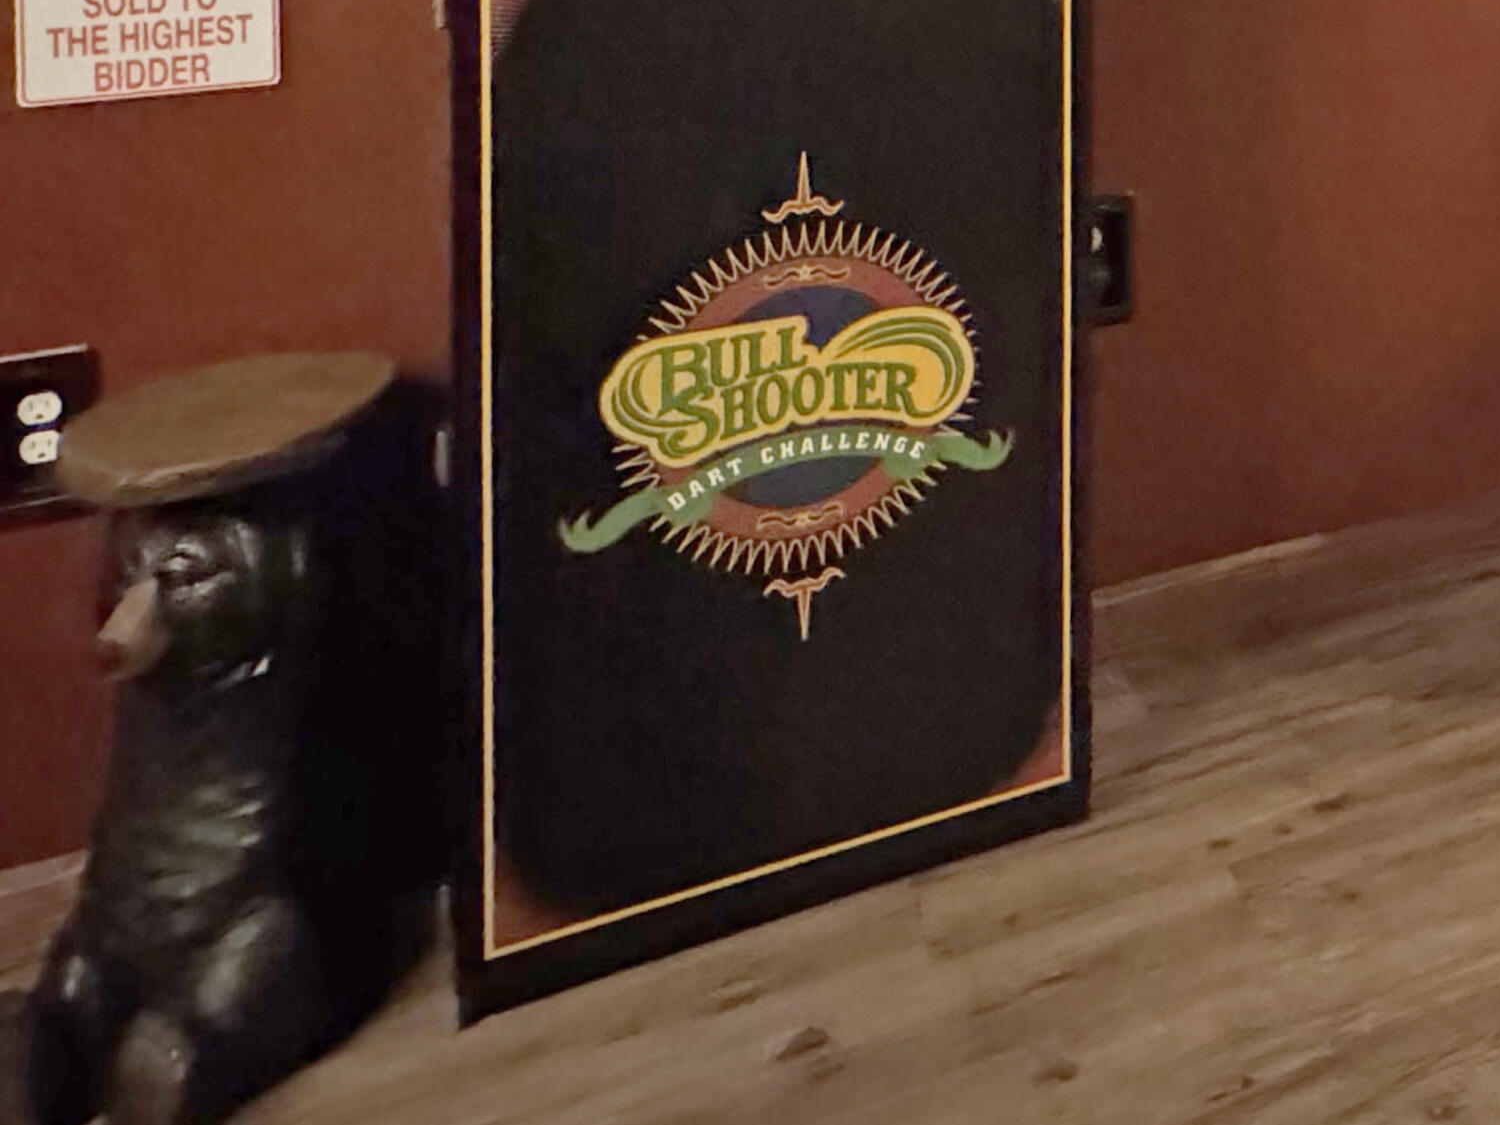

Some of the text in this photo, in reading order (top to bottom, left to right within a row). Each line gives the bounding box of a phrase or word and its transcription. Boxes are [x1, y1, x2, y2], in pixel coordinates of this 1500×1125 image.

[46, 14, 253, 58] THE HIGHEST
[94, 53, 211, 92] BIDDER
[658, 325, 809, 418] BULL
[658, 362, 930, 460] SHOOTER
[760, 431, 926, 465] CHALLENGE
[667, 457, 744, 512] DART
